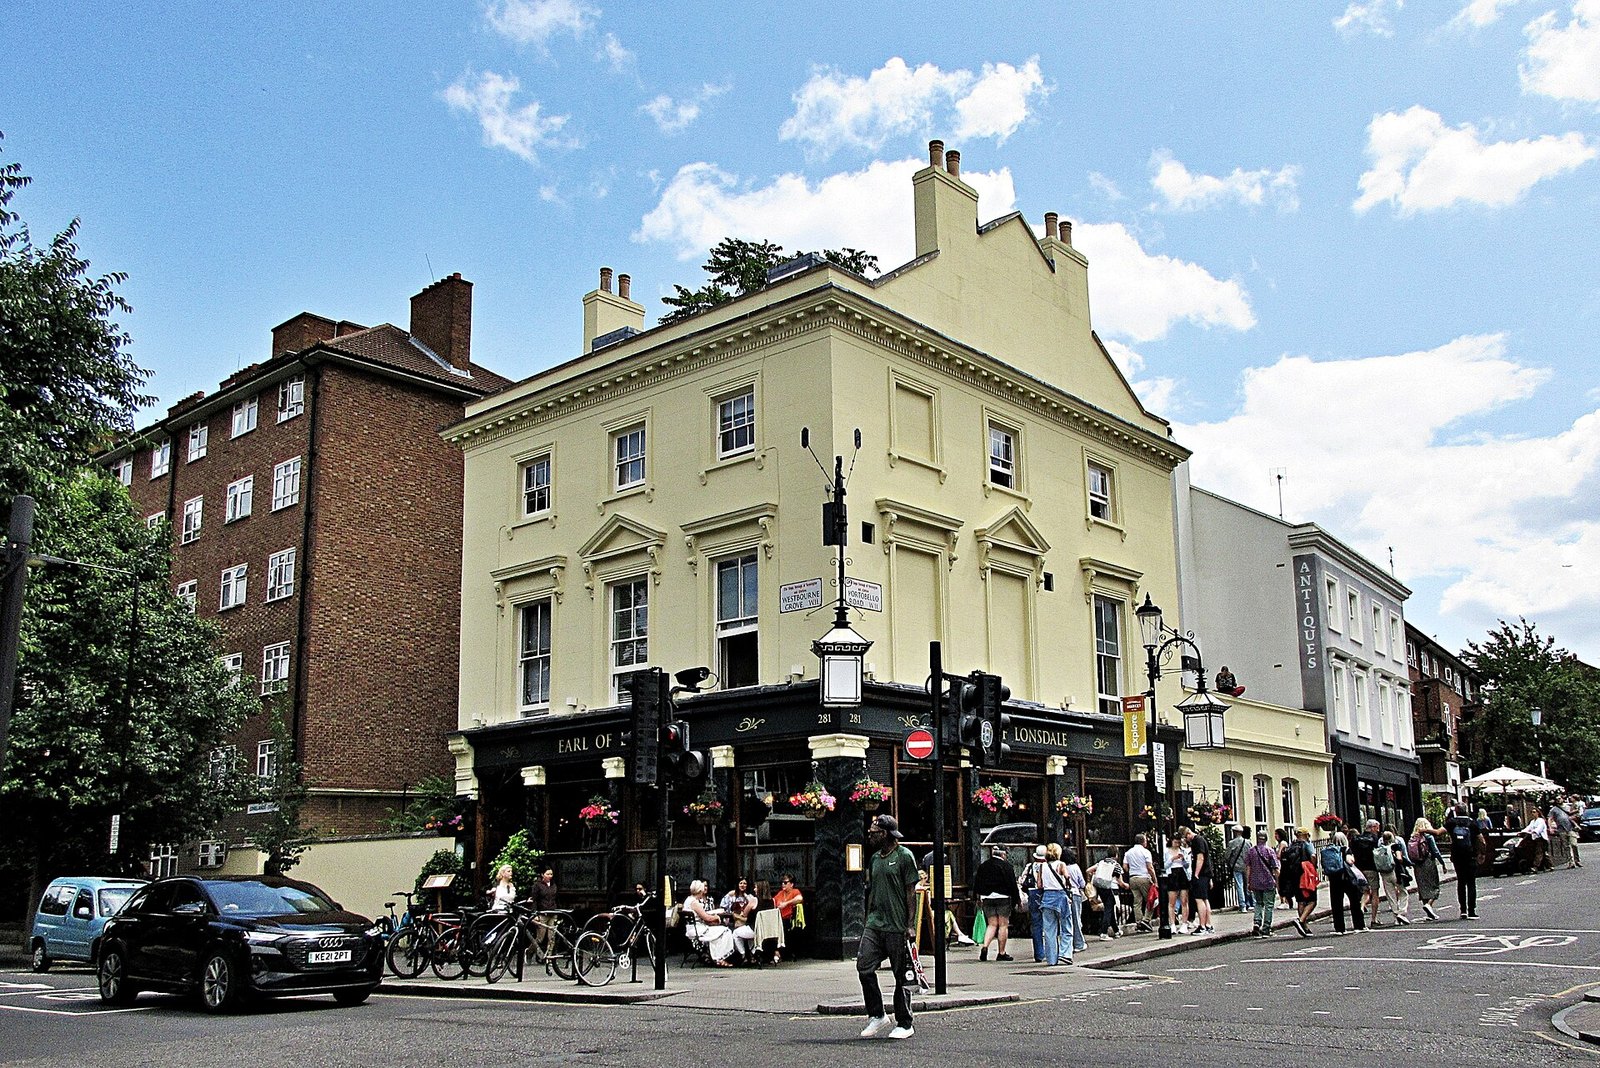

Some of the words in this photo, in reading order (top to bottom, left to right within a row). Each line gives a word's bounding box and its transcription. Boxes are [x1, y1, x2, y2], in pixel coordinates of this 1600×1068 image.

[782, 590, 820, 603] WESTBOURNE
[848, 590, 879, 602] PORTOBELLO
[849, 597, 864, 606] ROAD
[785, 601, 803, 610] GROVE
[1300, 562, 1317, 669] ANTIQUES
[818, 713, 831, 724] 281
[849, 713, 861, 724] 281
[1014, 727, 1067, 747] LONSDALE
[1131, 714, 1139, 749] Explore
[558, 736, 589, 754] EARL
[595, 732, 612, 749] OF
